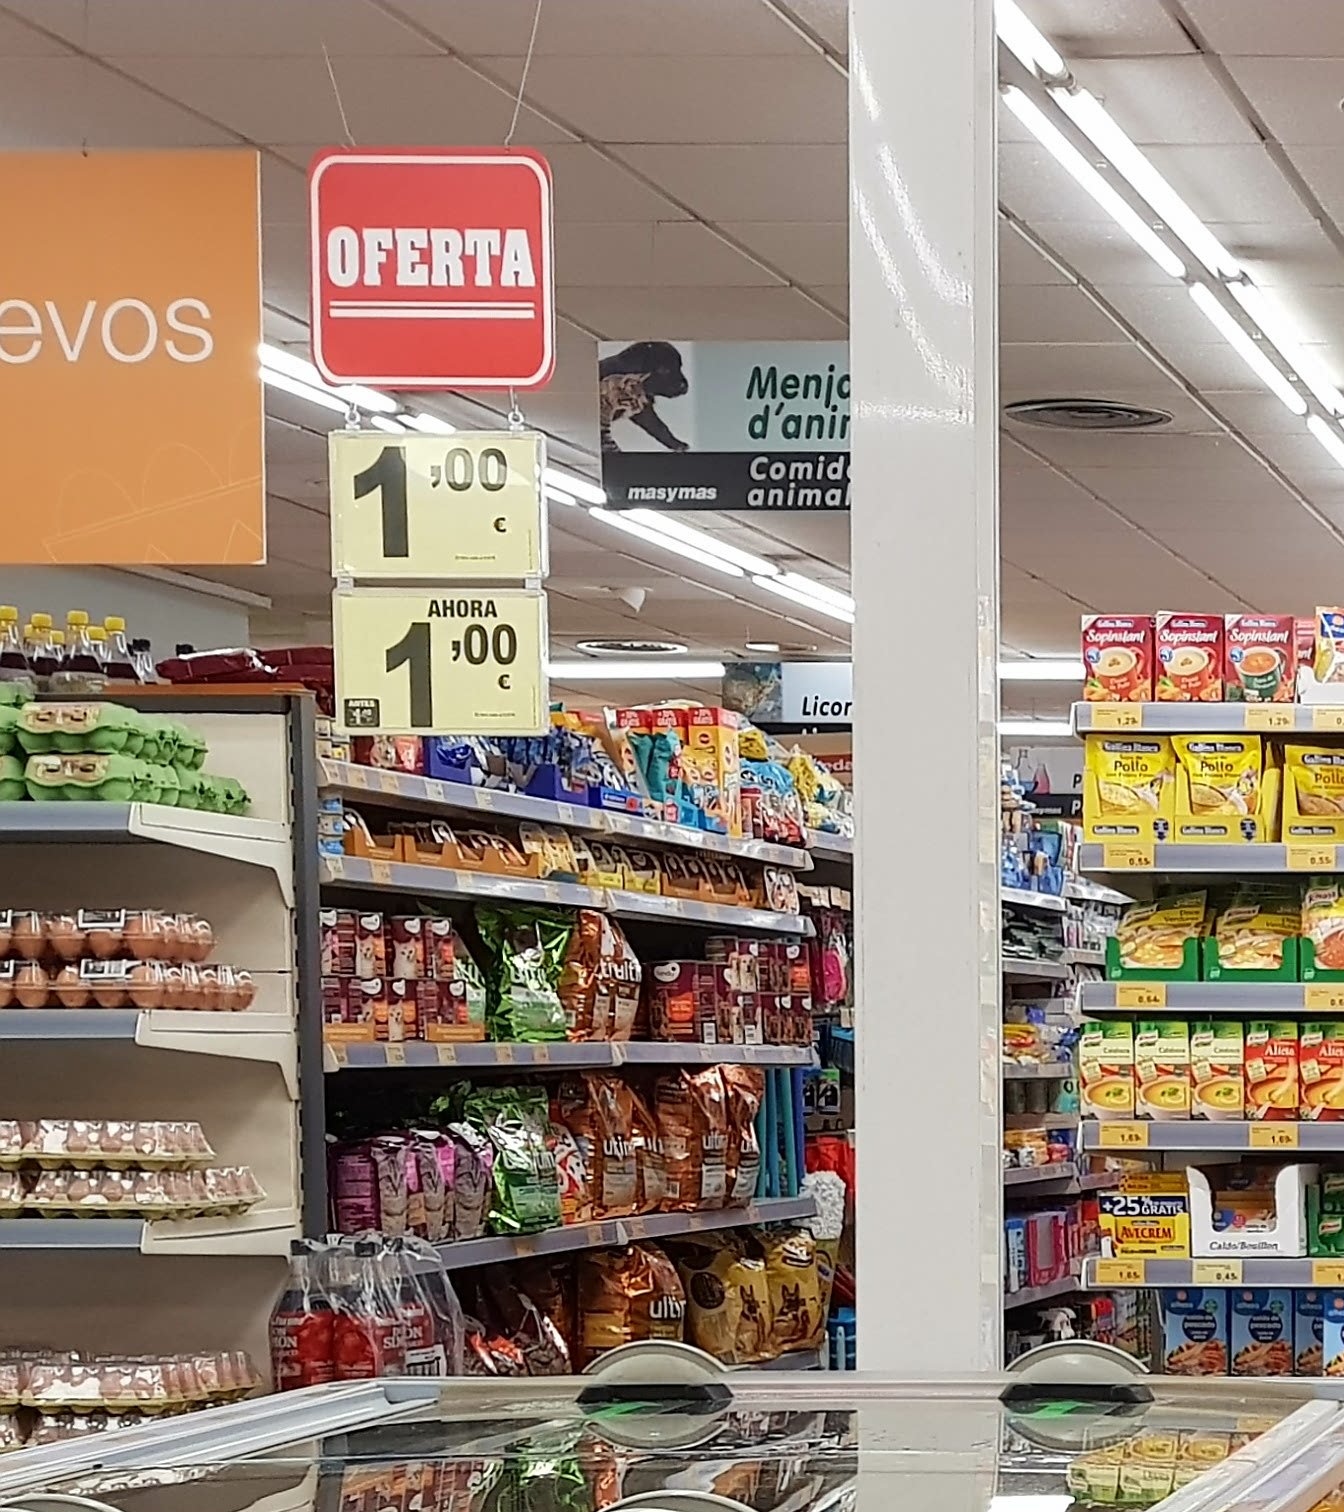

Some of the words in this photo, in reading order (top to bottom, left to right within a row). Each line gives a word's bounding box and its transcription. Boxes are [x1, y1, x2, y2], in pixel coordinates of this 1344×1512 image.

[327, 227, 537, 289] OFERTA
[749, 455, 850, 482] Comid
[627, 485, 718, 503] masymas
[428, 599, 498, 619] AHORA
[1086, 629, 1146, 644] Sopinstant
[1159, 629, 1218, 643] Sopinstant
[1230, 628, 1289, 643] Sopinstant
[1113, 760, 1149, 774] Pollo
[1200, 760, 1235, 774] Pollo
[1264, 1044, 1296, 1058] Alicia
[1142, 1204, 1184, 1216] GRATIS
[1121, 1225, 1172, 1240] AVECREM
